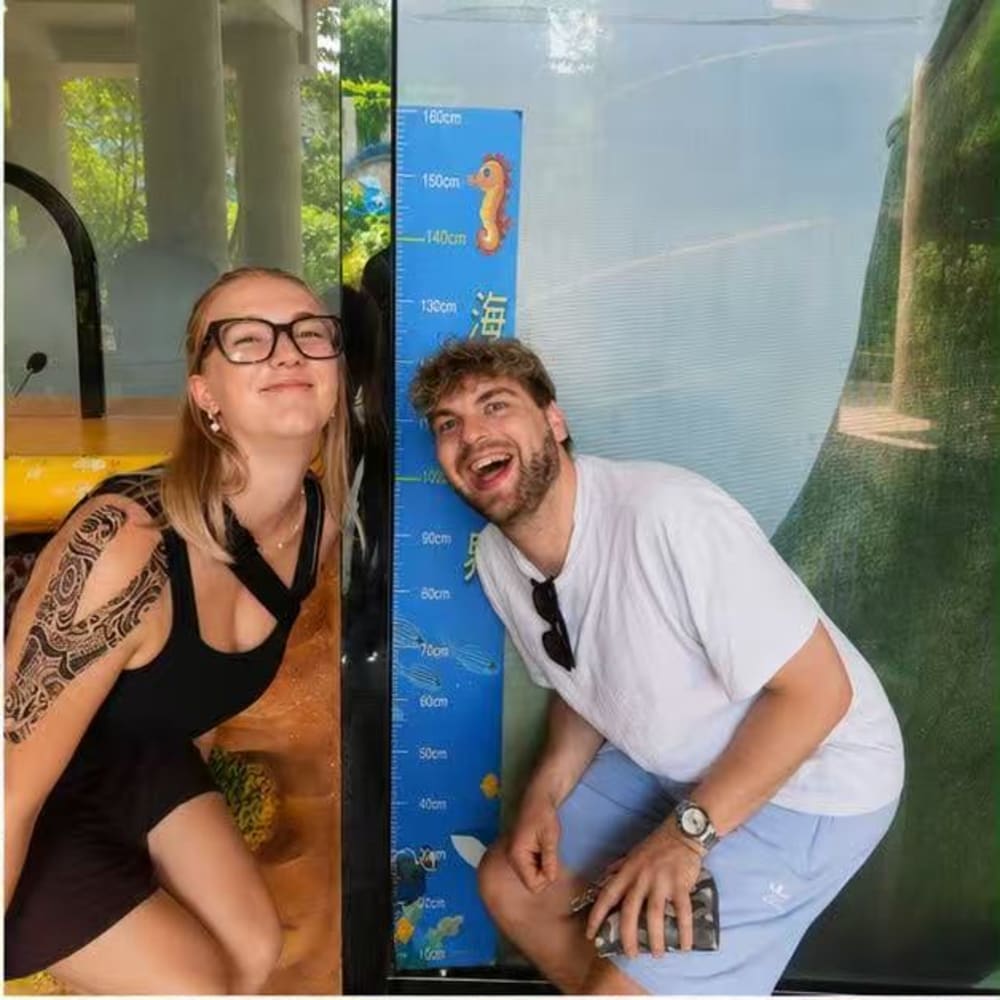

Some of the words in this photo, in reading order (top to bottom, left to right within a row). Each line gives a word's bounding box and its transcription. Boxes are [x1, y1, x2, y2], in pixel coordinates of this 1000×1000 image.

[423, 110, 462, 125] 160cm
[422, 174, 460, 189] 150cm
[426, 230, 466, 245] 140cm
[421, 300, 457, 313] 130cm
[421, 532, 451, 544] 90cm
[419, 695, 448, 707] 60cm
[419, 748, 447, 760] 50cm
[419, 799, 447, 810] 40cm
